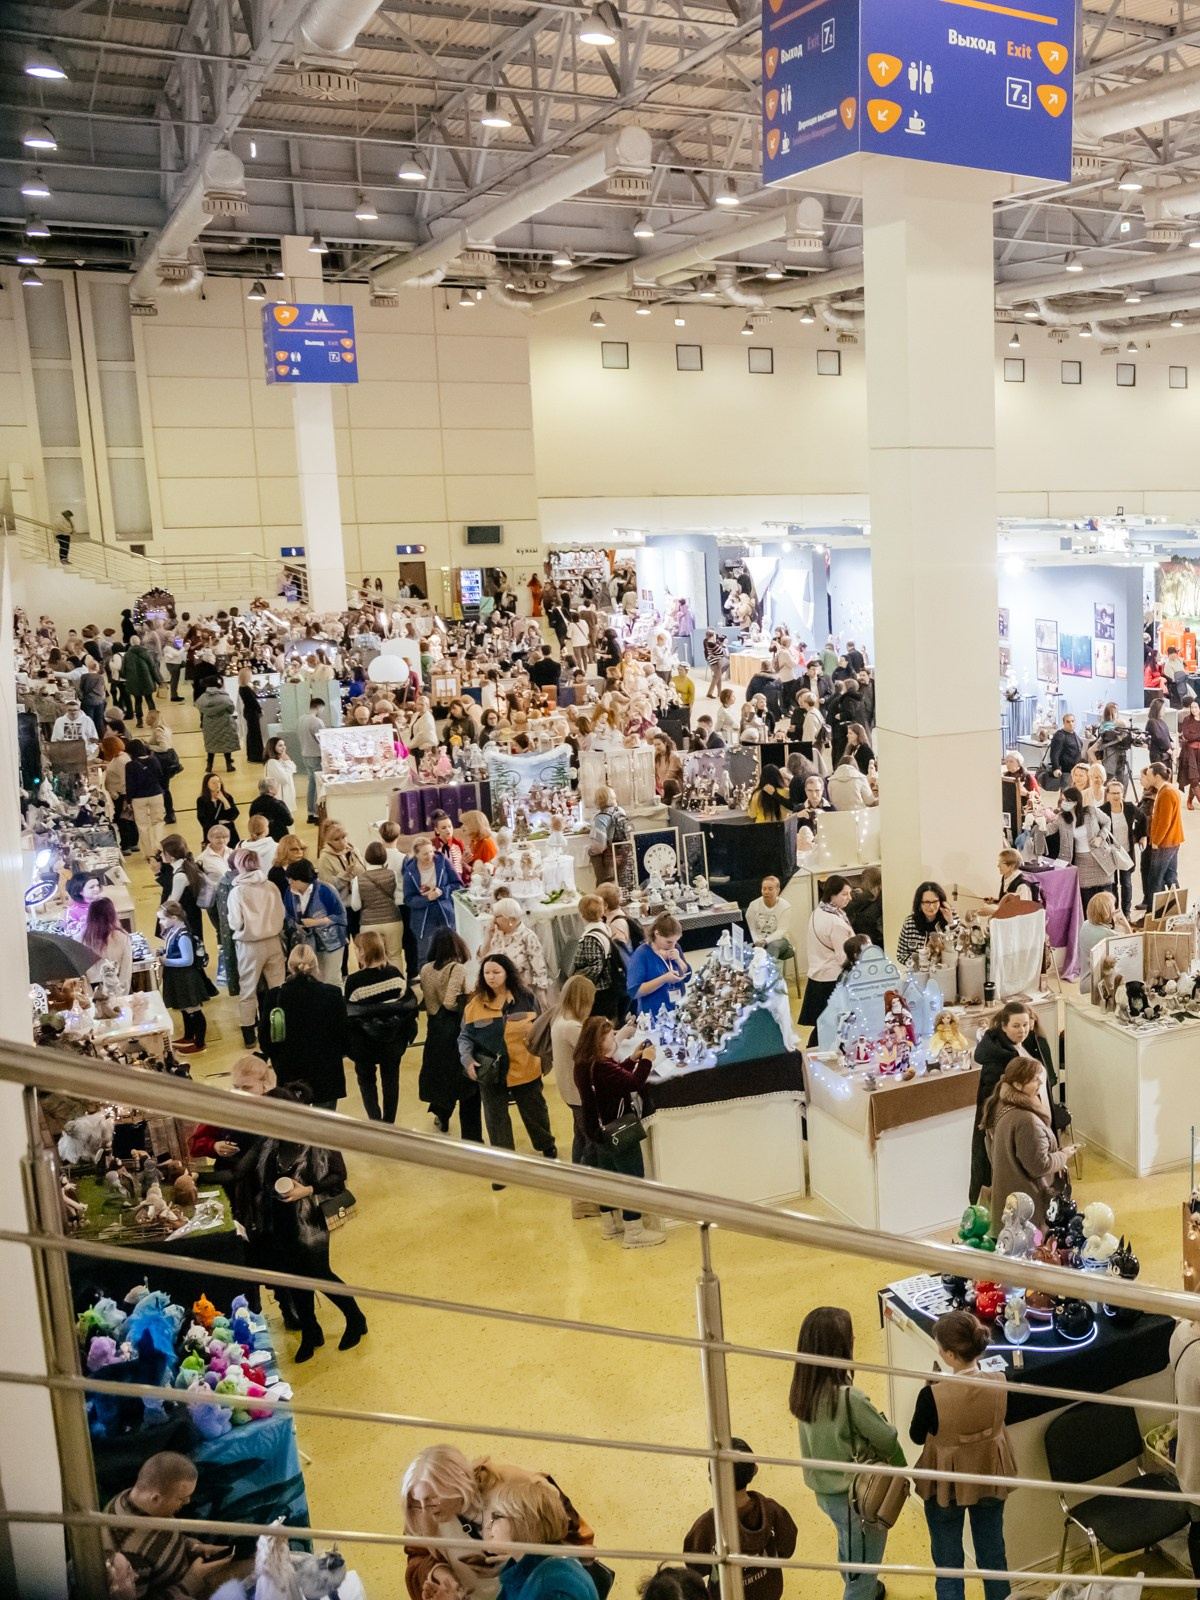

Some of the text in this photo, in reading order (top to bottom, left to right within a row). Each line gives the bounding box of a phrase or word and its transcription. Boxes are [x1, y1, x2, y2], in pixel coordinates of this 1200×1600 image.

[780, 44, 803, 64] Выход
[948, 29, 1032, 59] Выход Exit
